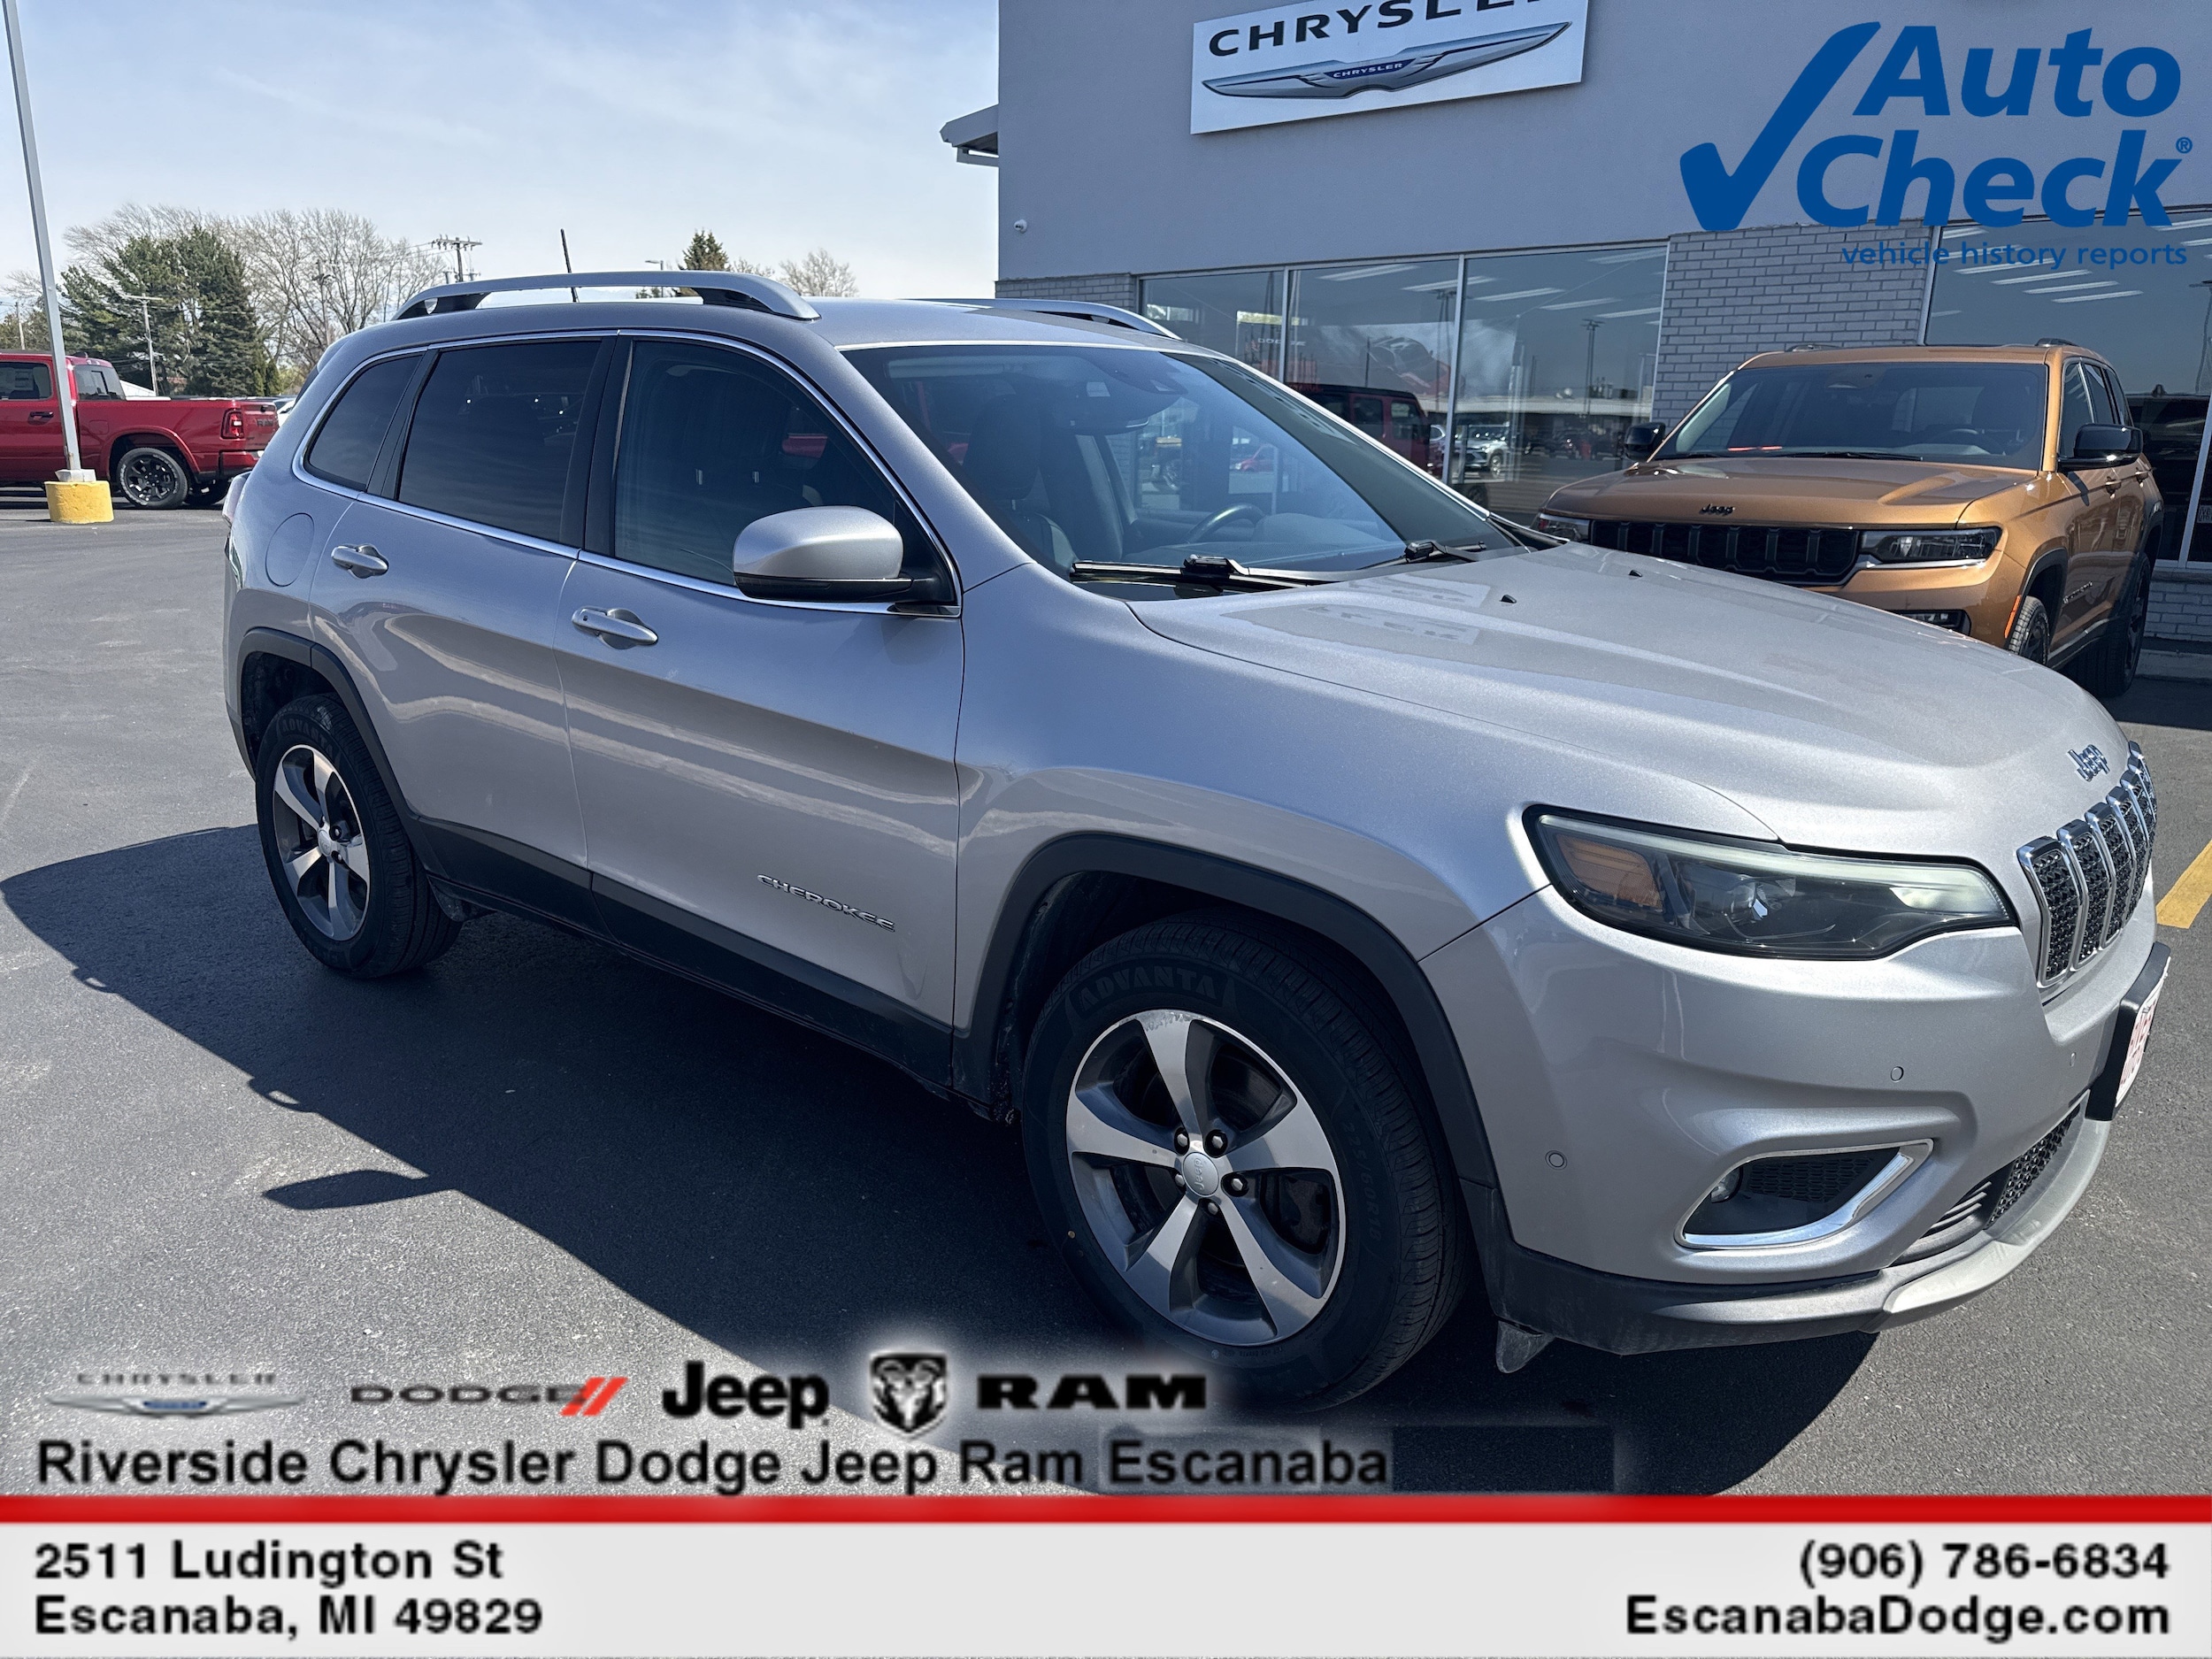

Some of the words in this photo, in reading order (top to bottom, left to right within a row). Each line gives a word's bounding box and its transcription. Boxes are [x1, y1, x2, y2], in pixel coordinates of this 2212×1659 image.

[1209, 0, 1542, 57] CHRYSL
[1333, 63, 1403, 78] CHRYSLER
[1699, 503, 1735, 517] Jeep
[757, 873, 895, 932] CHEROKEE
[1079, 965, 1226, 1012] ADVANTA
[1194, 1158, 1204, 1191] Jeep
